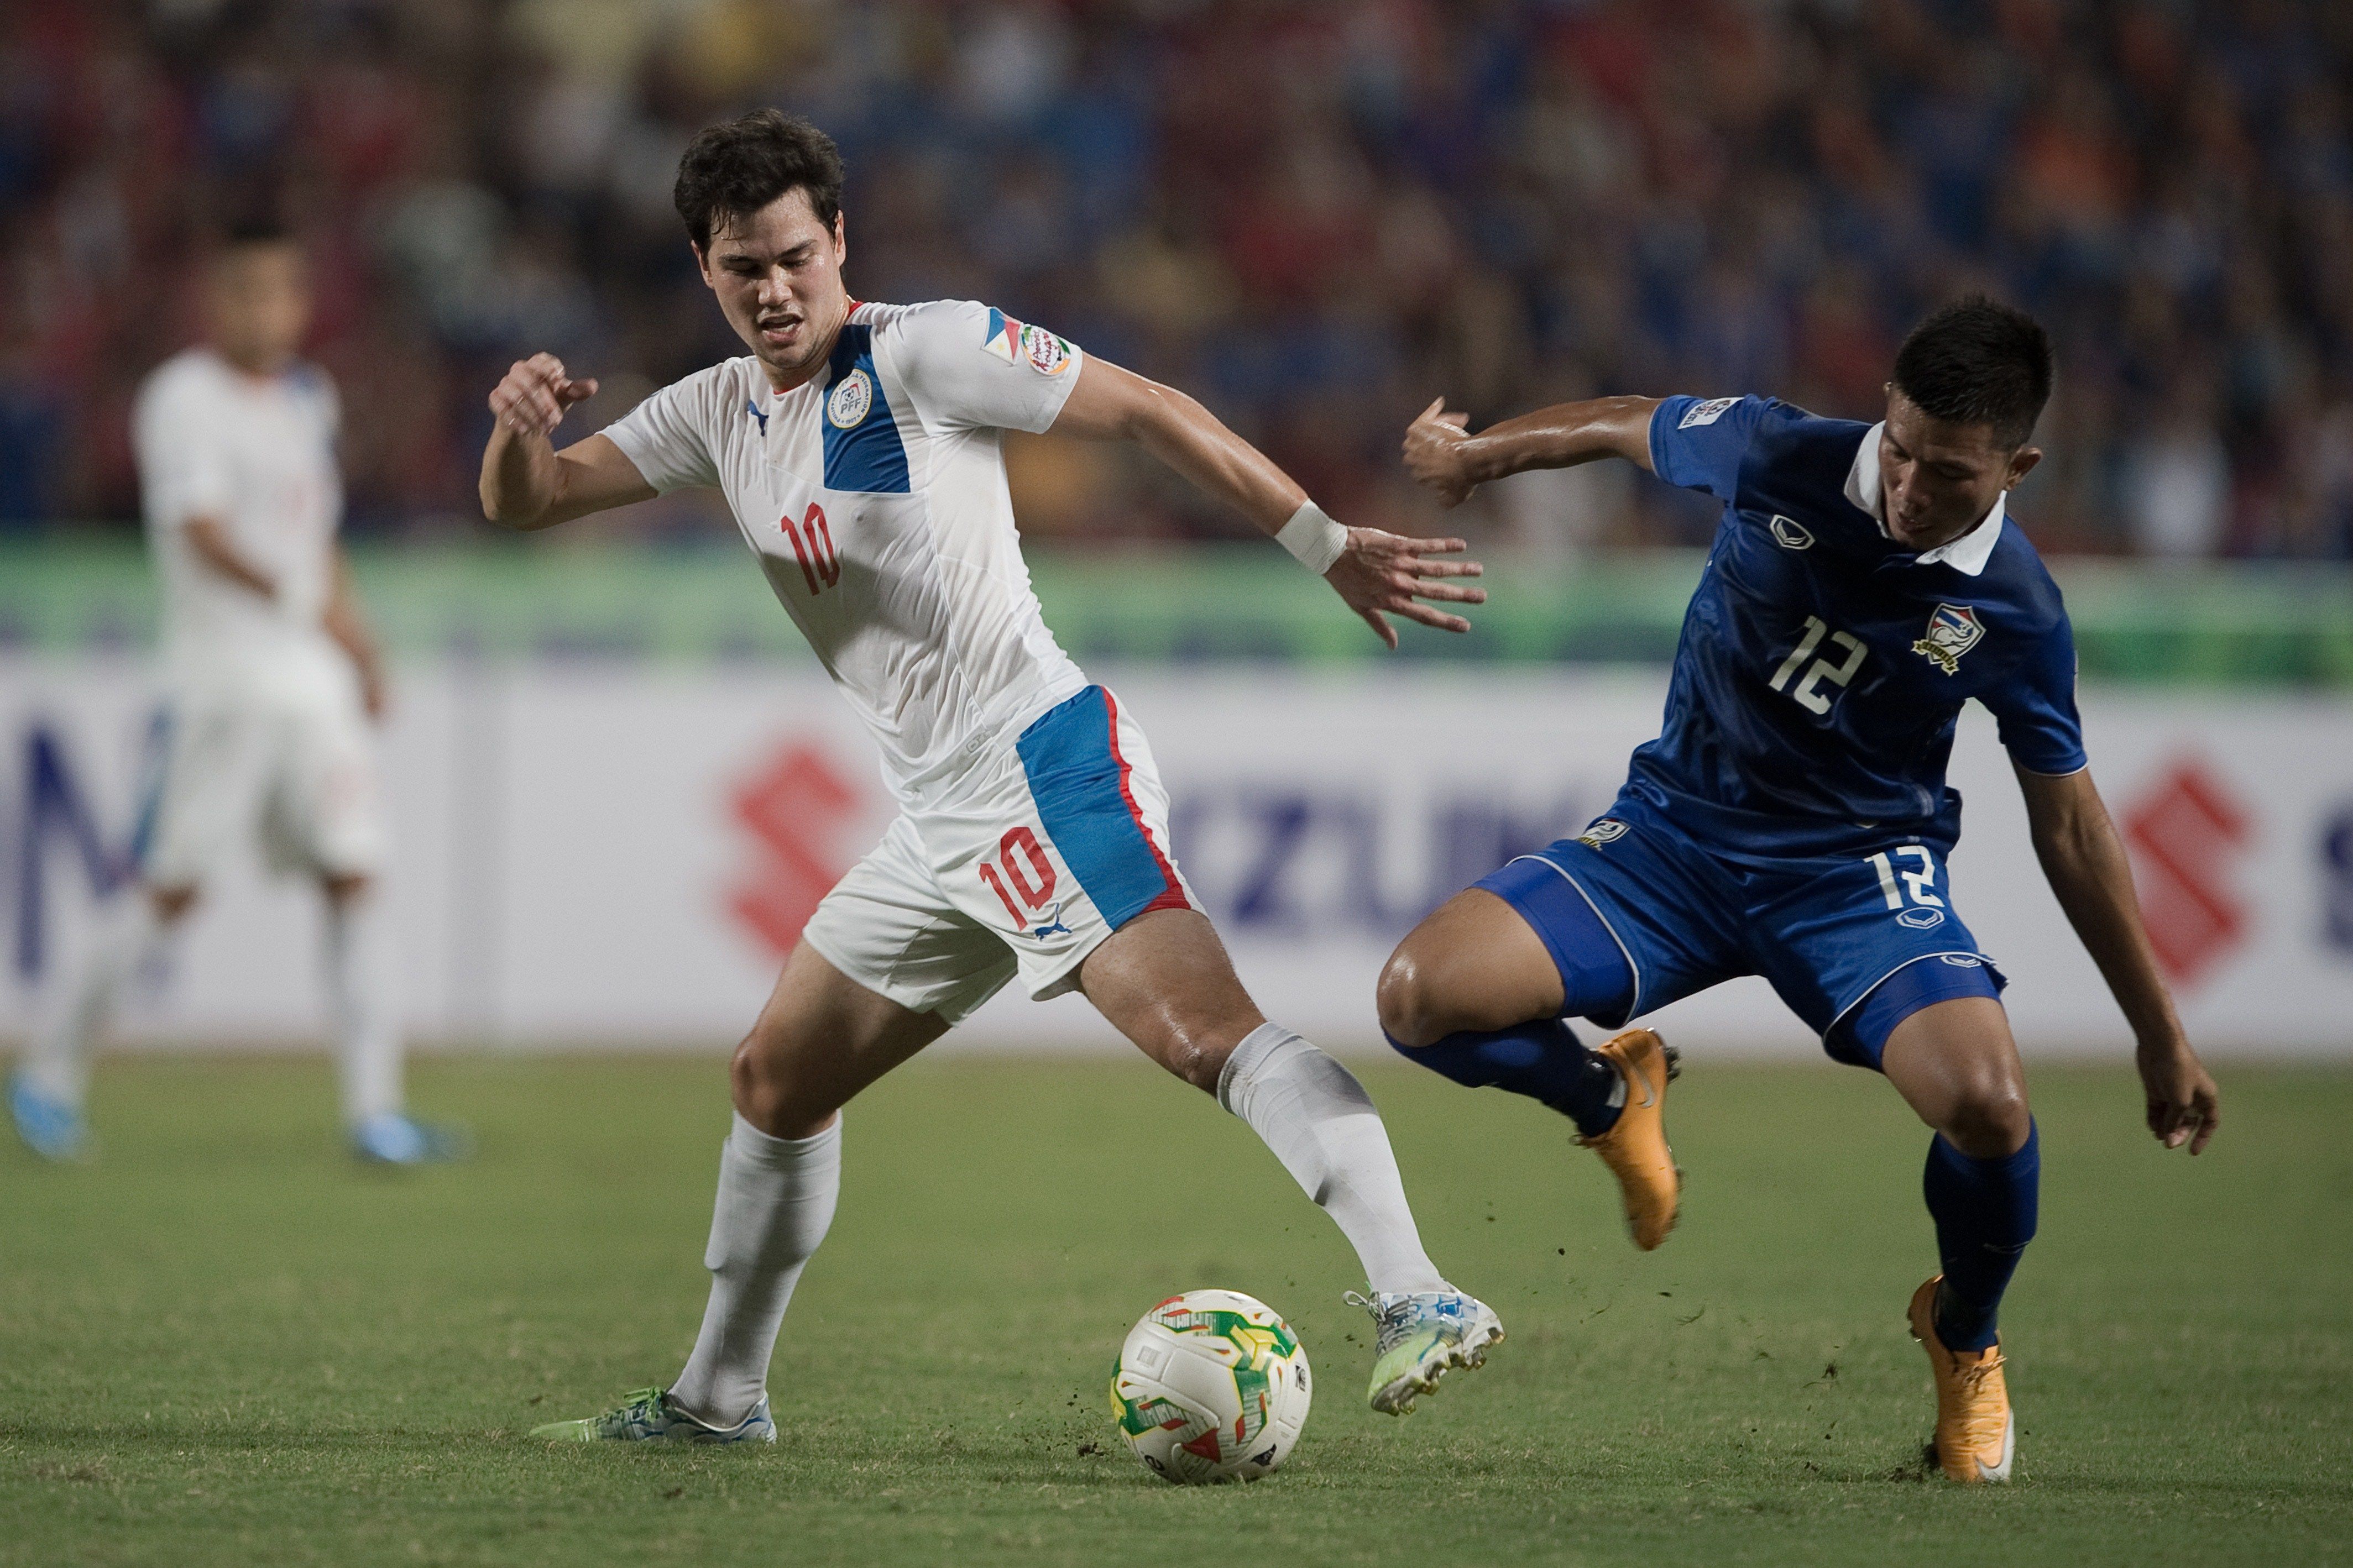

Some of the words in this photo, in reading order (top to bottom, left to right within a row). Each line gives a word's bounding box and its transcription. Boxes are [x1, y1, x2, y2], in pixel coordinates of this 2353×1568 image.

[840, 397, 861, 415] PFF
[781, 501, 840, 596] 10
[1768, 615, 1869, 715] 12
[979, 826, 1057, 932] 10
[1863, 845, 1946, 910] 12
